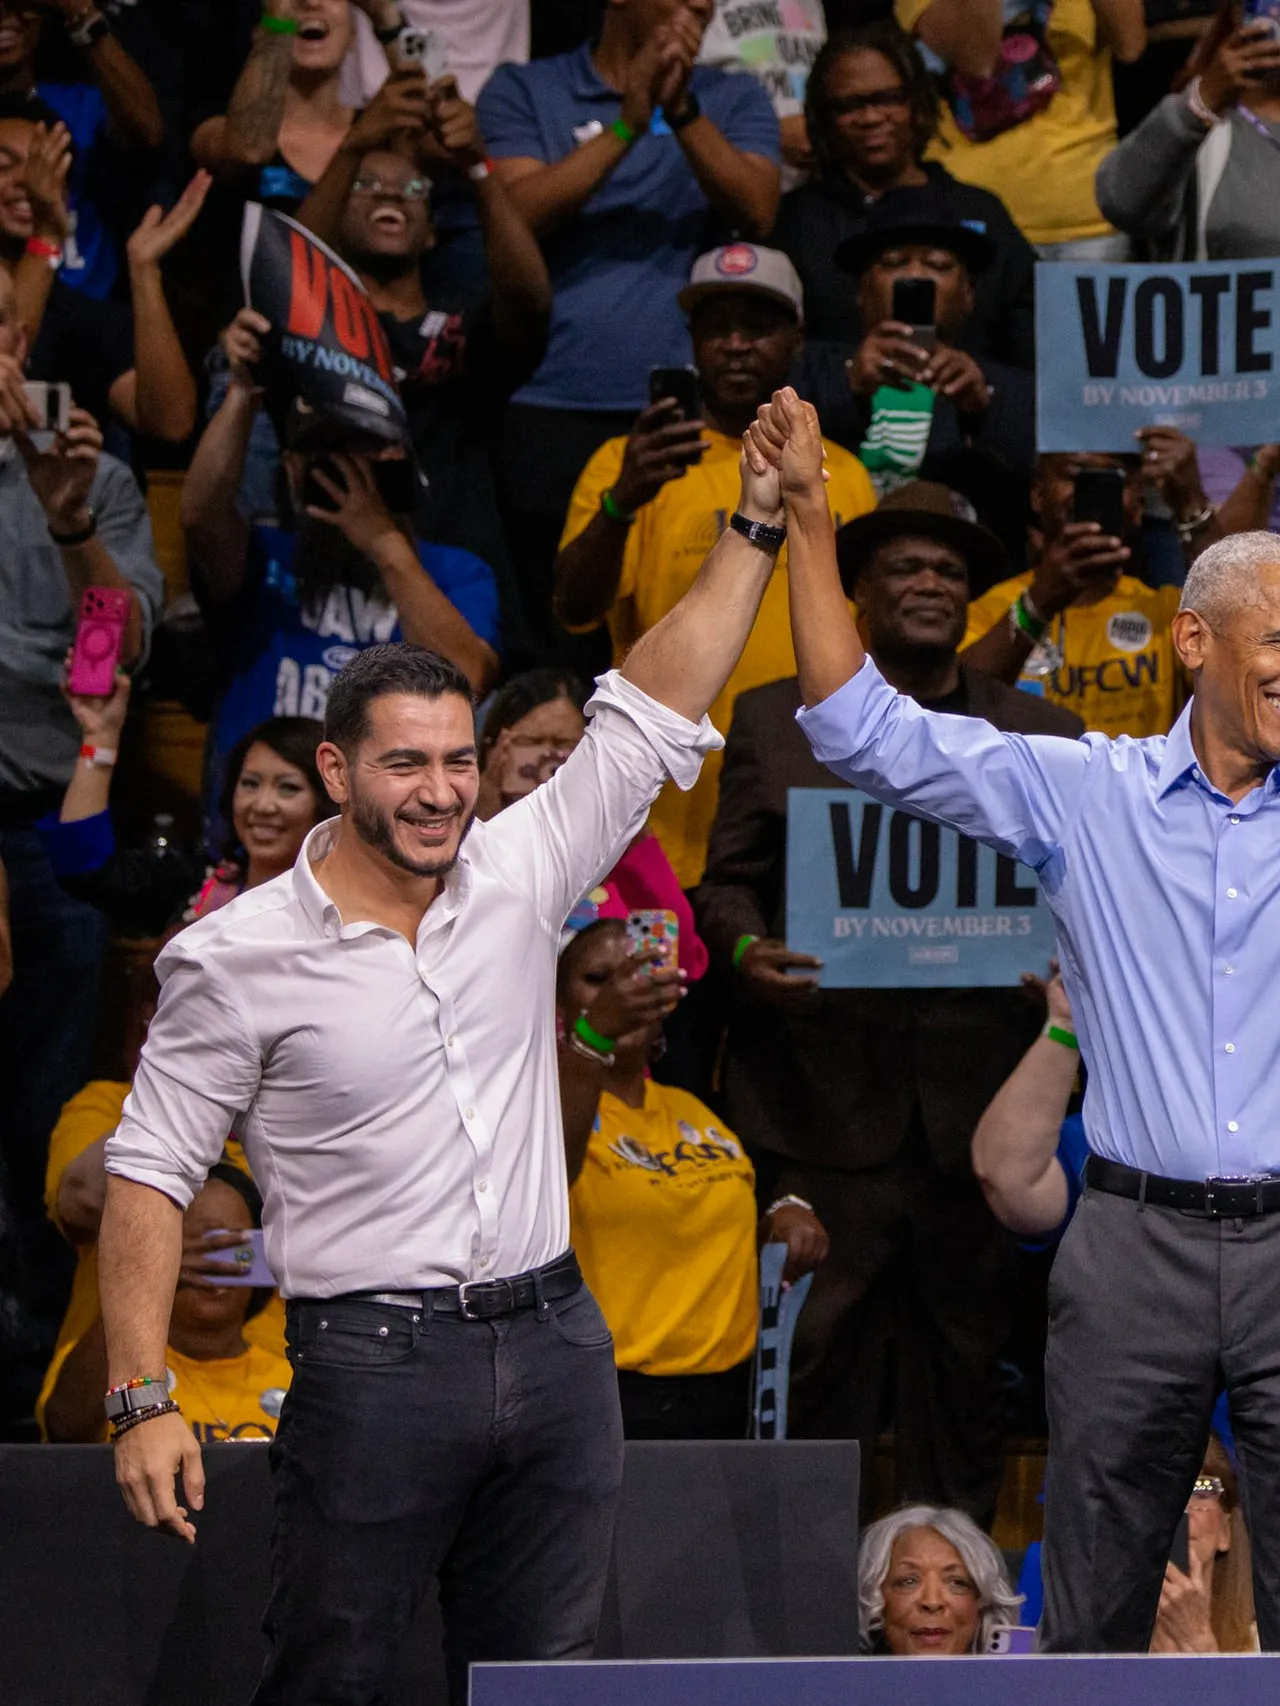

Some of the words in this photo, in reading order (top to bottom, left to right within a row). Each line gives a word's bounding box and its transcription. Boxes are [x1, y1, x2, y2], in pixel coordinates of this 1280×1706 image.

[1076, 271, 1274, 379] VOTE
[1083, 385, 1116, 407] BY
[1119, 380, 1252, 407] NOVEMBER
[1255, 379, 1271, 399] 3
[1052, 652, 1158, 698] UFCW
[833, 916, 868, 938] BY
[872, 915, 1012, 938] NOVEMBER
[1017, 914, 1032, 936] 3
